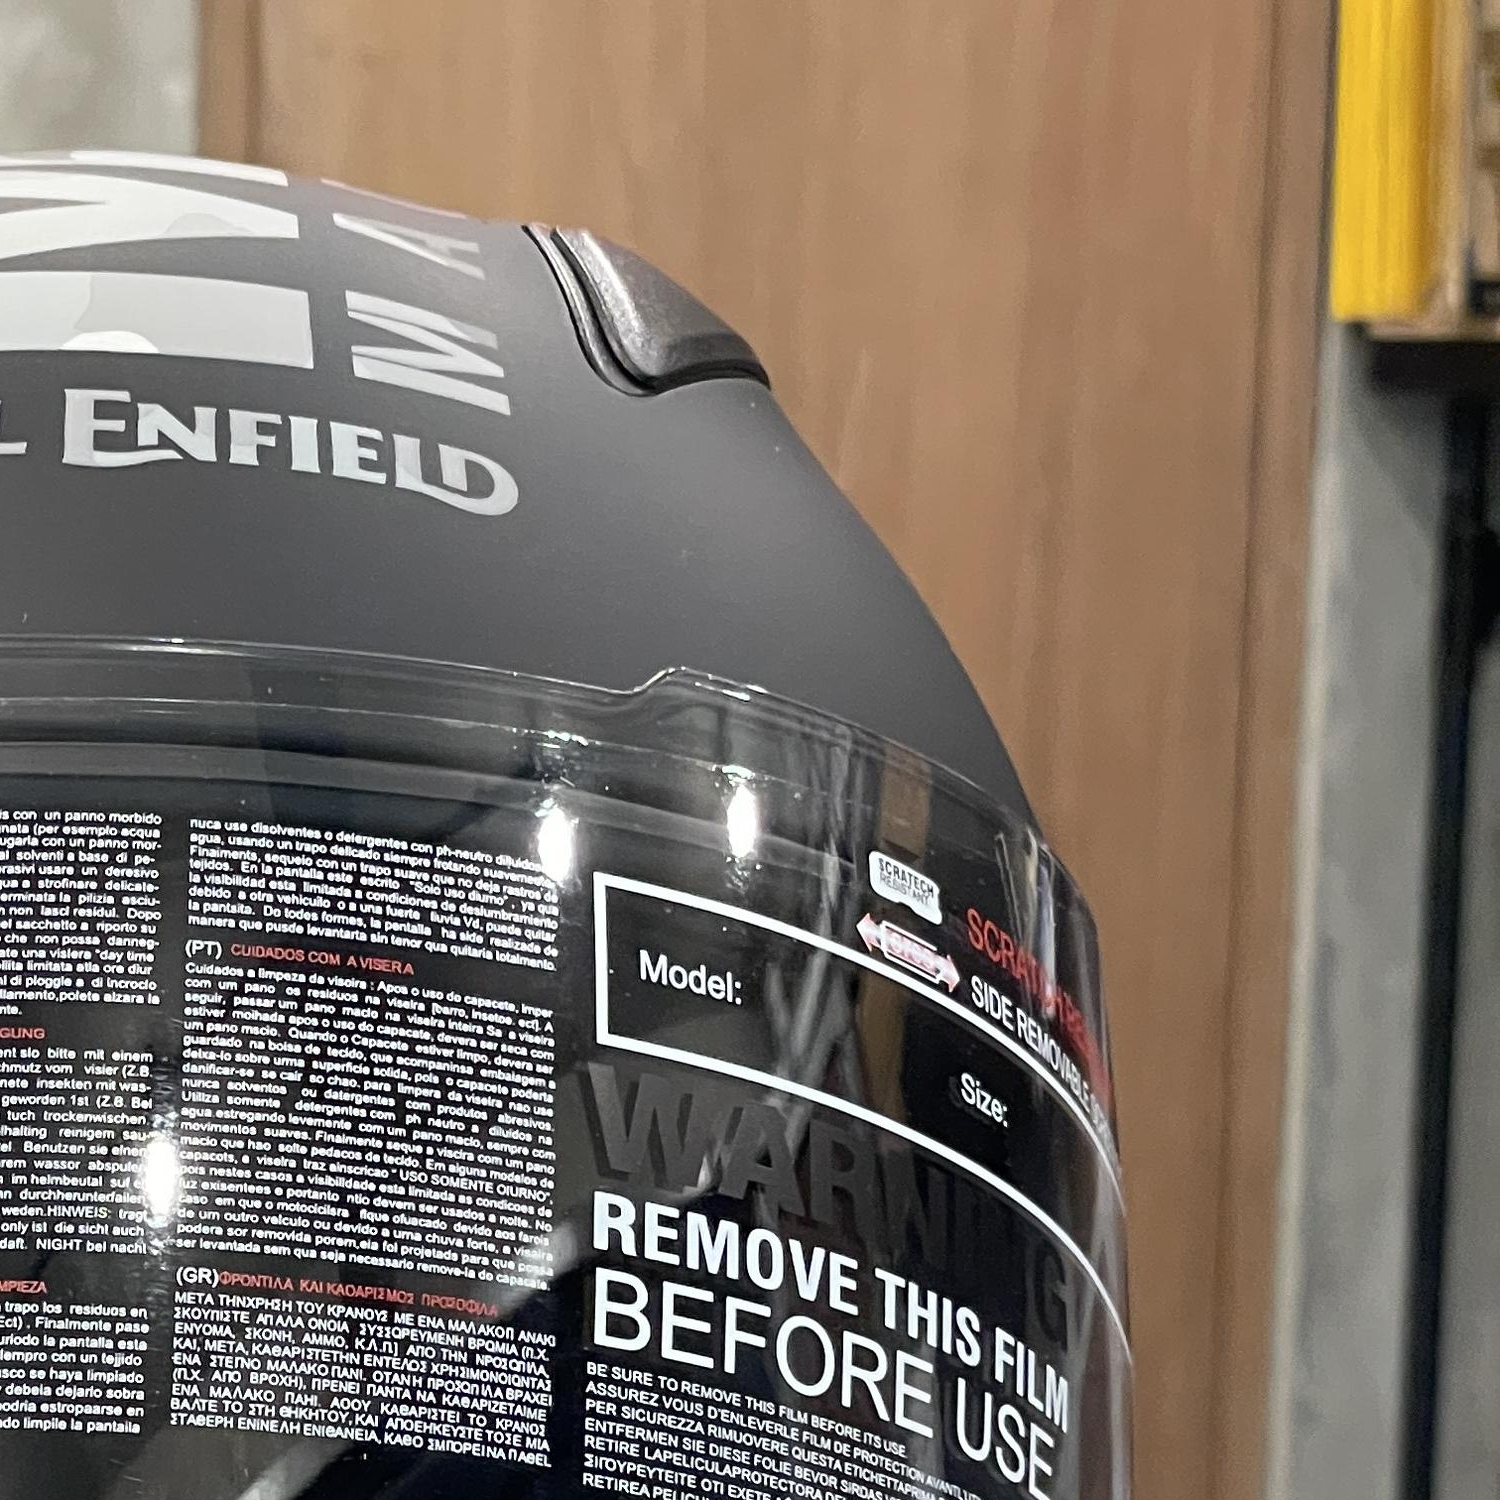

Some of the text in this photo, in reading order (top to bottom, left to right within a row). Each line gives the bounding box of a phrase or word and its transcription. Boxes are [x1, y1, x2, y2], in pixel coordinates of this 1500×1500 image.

[62, 387, 519, 516] ENFIELD
[185, 939, 223, 960] (PT)
[230, 942, 306, 964] CUIDADOS
[308, 949, 341, 966] COM
[639, 949, 743, 1005] Model:
[971, 975, 1014, 1031] SIDE
[961, 1072, 1008, 1127] Size:
[593, 1190, 1069, 1434] REMOVE THIS FILM
[593, 1267, 934, 1439] BEFORE
[584, 1434, 640, 1457] RETIRE
[585, 1381, 659, 1407] ASSUREZ
[662, 1397, 704, 1416] VOUS
[802, 1430, 831, 1451] FILM
[834, 1441, 851, 1457] DE
[585, 1399, 617, 1416] PER
[621, 1406, 705, 1435] SICUREZZA
[708, 1424, 789, 1456] RIMUOVERE
[792, 1448, 843, 1472] QUESTA
[586, 1361, 908, 1458] BE SURE TO REMOVE THIS FILM BEFORE ITS USE
[585, 1417, 679, 1448] ENTFERMEN
[682, 1437, 706, 1454] SIE
[708, 1442, 751, 1465] DIESE
[753, 1454, 792, 1476] FOLIE
[794, 1465, 838, 1491] BEVOR
